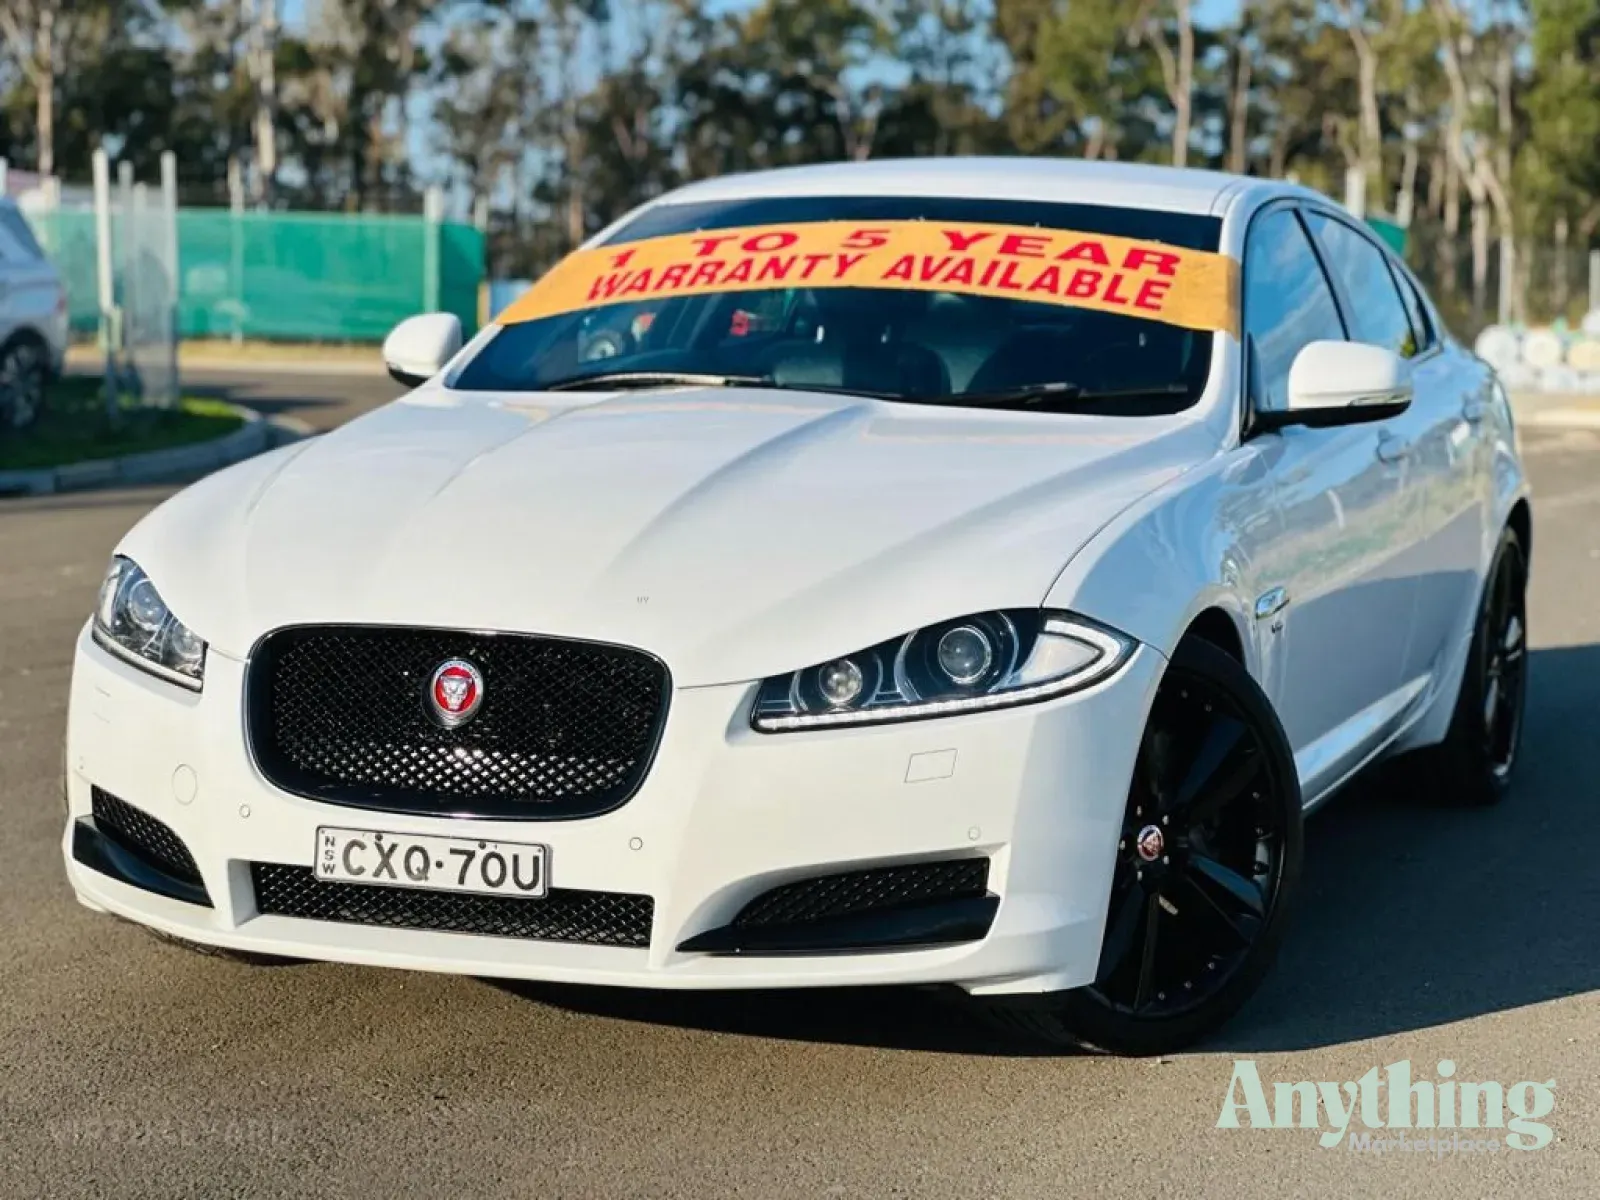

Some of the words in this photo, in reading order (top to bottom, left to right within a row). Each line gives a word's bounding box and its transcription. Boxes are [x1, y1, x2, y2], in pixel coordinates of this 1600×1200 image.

[613, 248, 637, 269] 1
[691, 233, 798, 257] TO
[840, 229, 890, 249] 5
[943, 230, 1182, 277] YEAR
[586, 253, 868, 302] WARRANTY
[880, 254, 1172, 311] AVAILABLE
[322, 835, 336, 875] NSW
